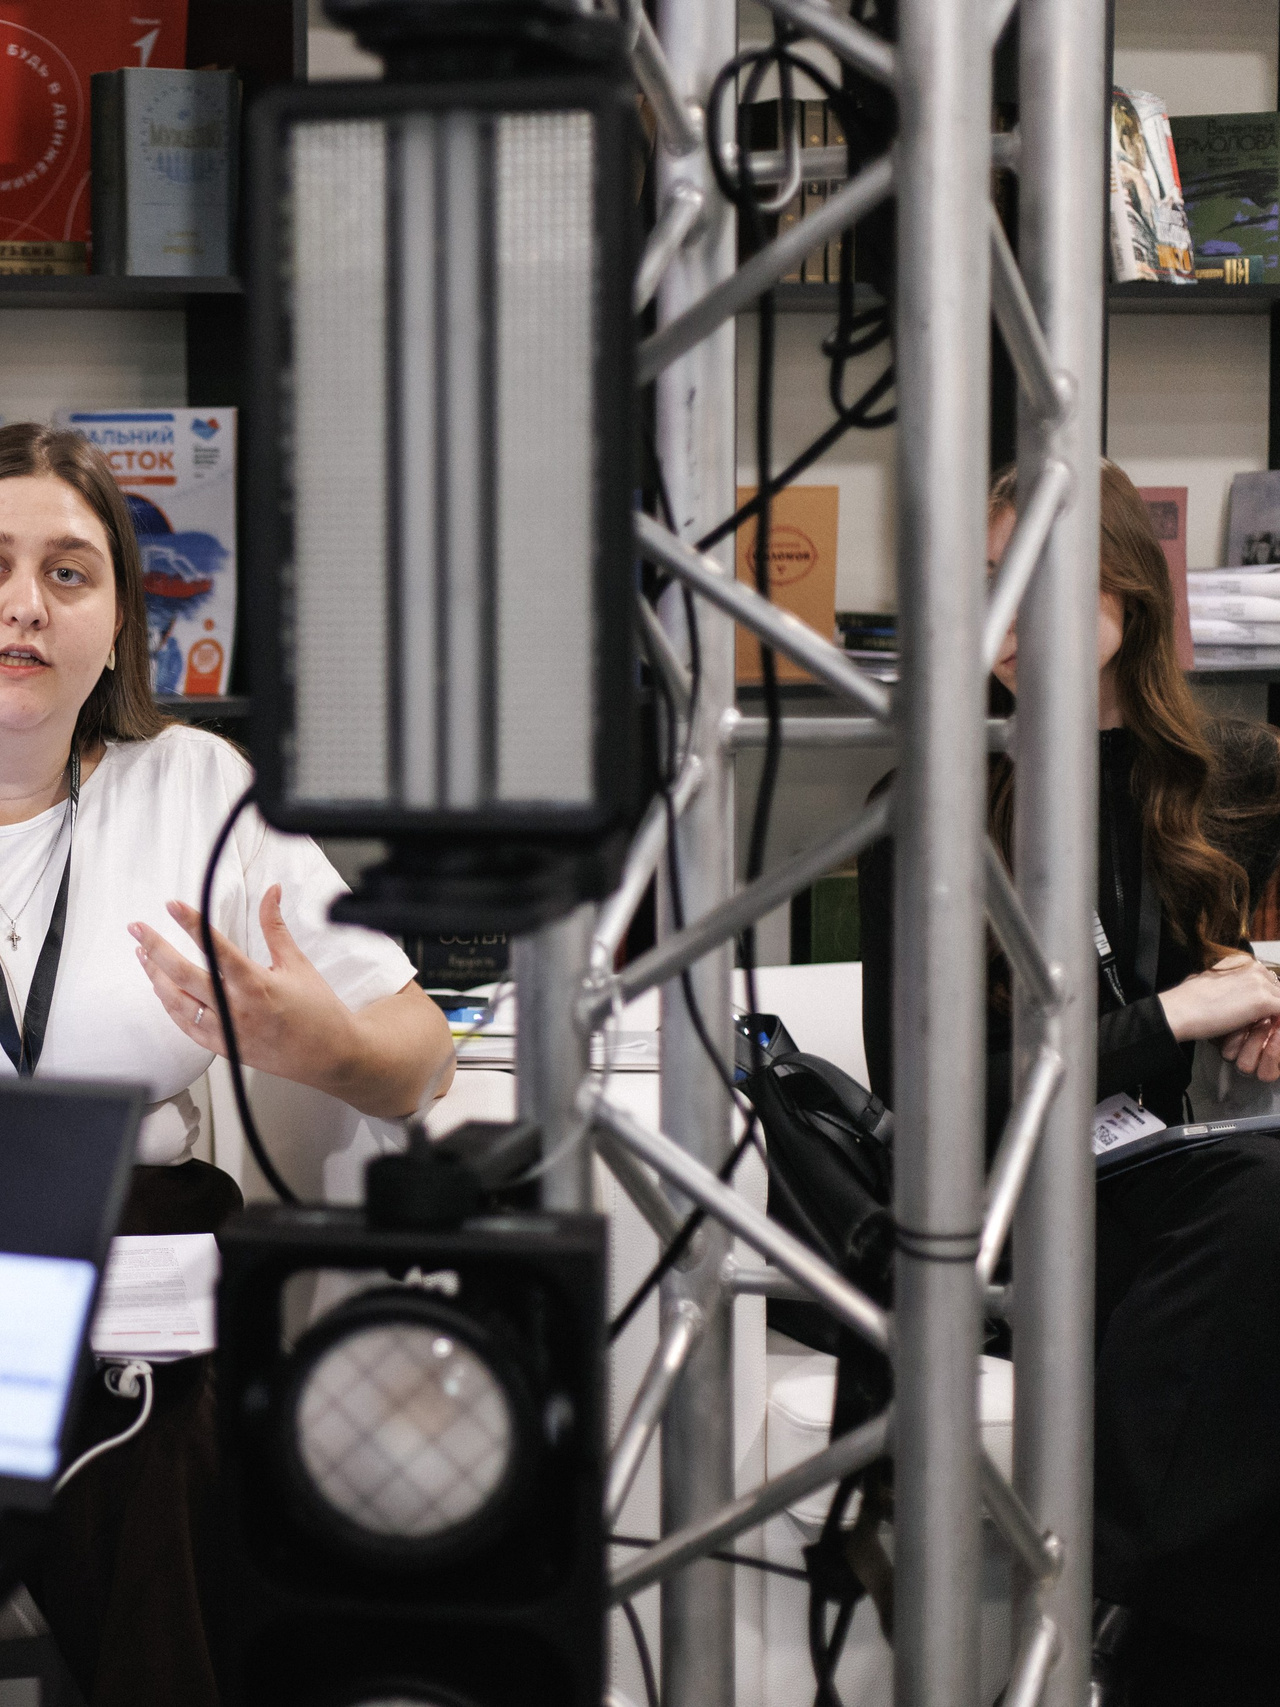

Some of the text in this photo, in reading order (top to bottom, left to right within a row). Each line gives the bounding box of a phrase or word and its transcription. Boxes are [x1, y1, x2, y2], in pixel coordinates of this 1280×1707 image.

[6, 42, 50, 78] БУДЬ
[47, 80, 62, 95] В
[103, 449, 175, 470] СТОК
